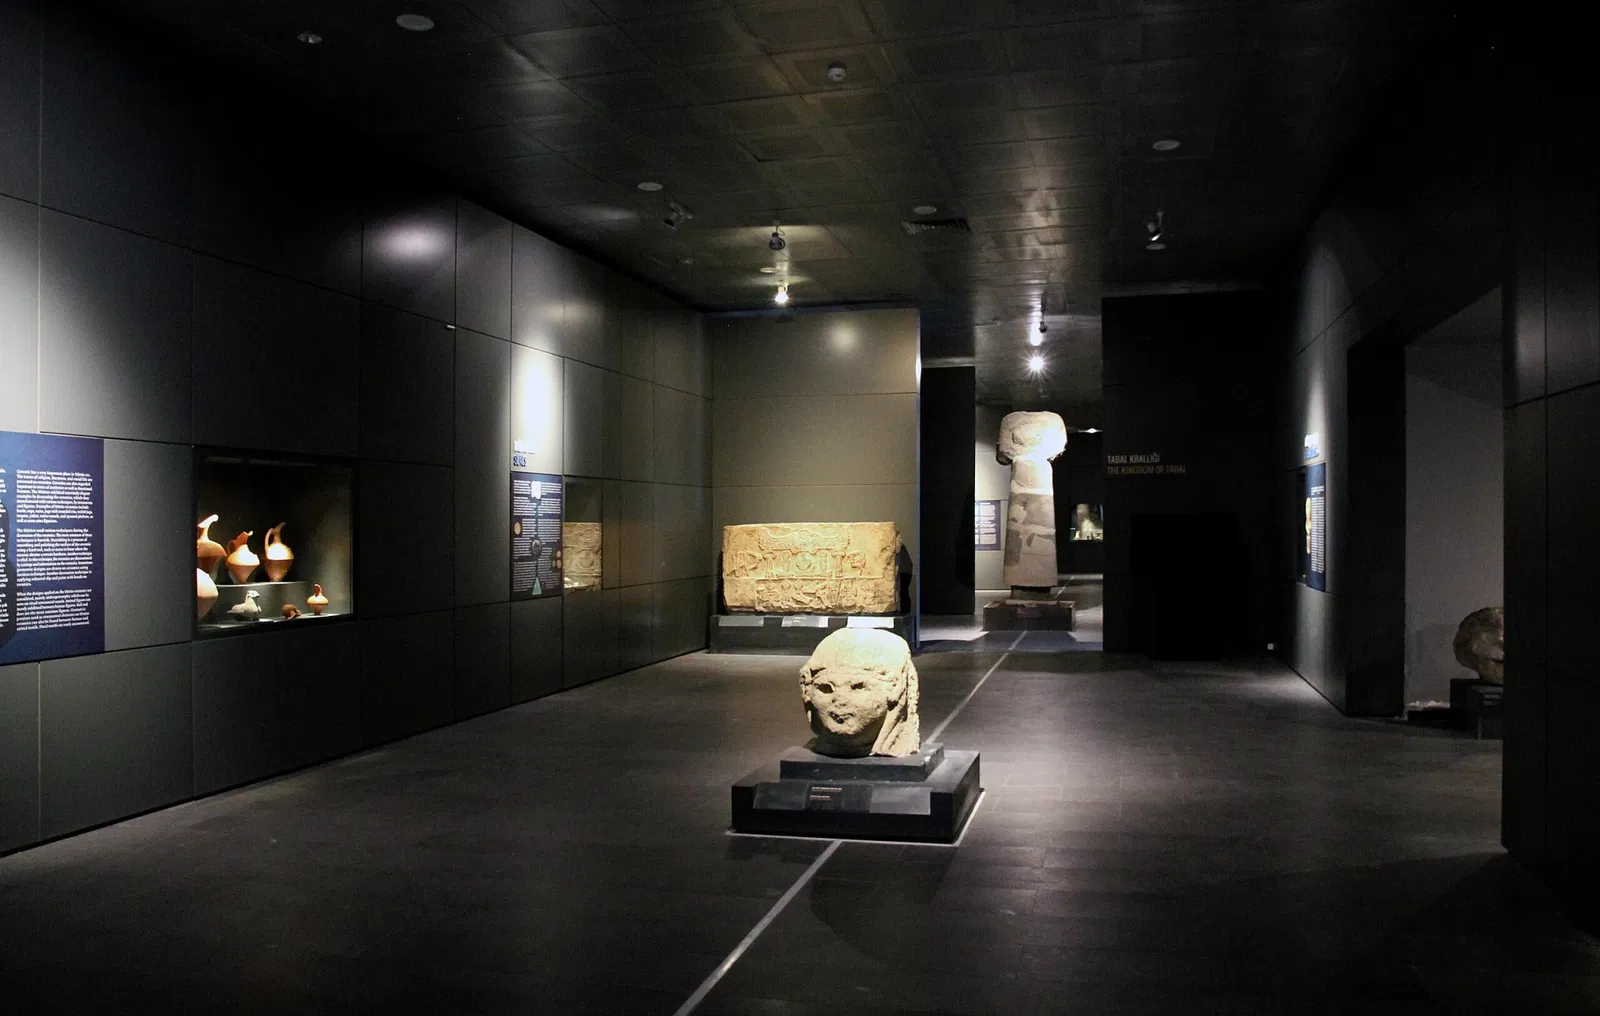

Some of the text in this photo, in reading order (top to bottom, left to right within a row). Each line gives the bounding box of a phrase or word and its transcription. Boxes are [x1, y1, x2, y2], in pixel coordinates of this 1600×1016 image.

[1107, 455, 1128, 464] TABAL
[1107, 464, 1186, 475] THE KINGDOM OF TABAL
